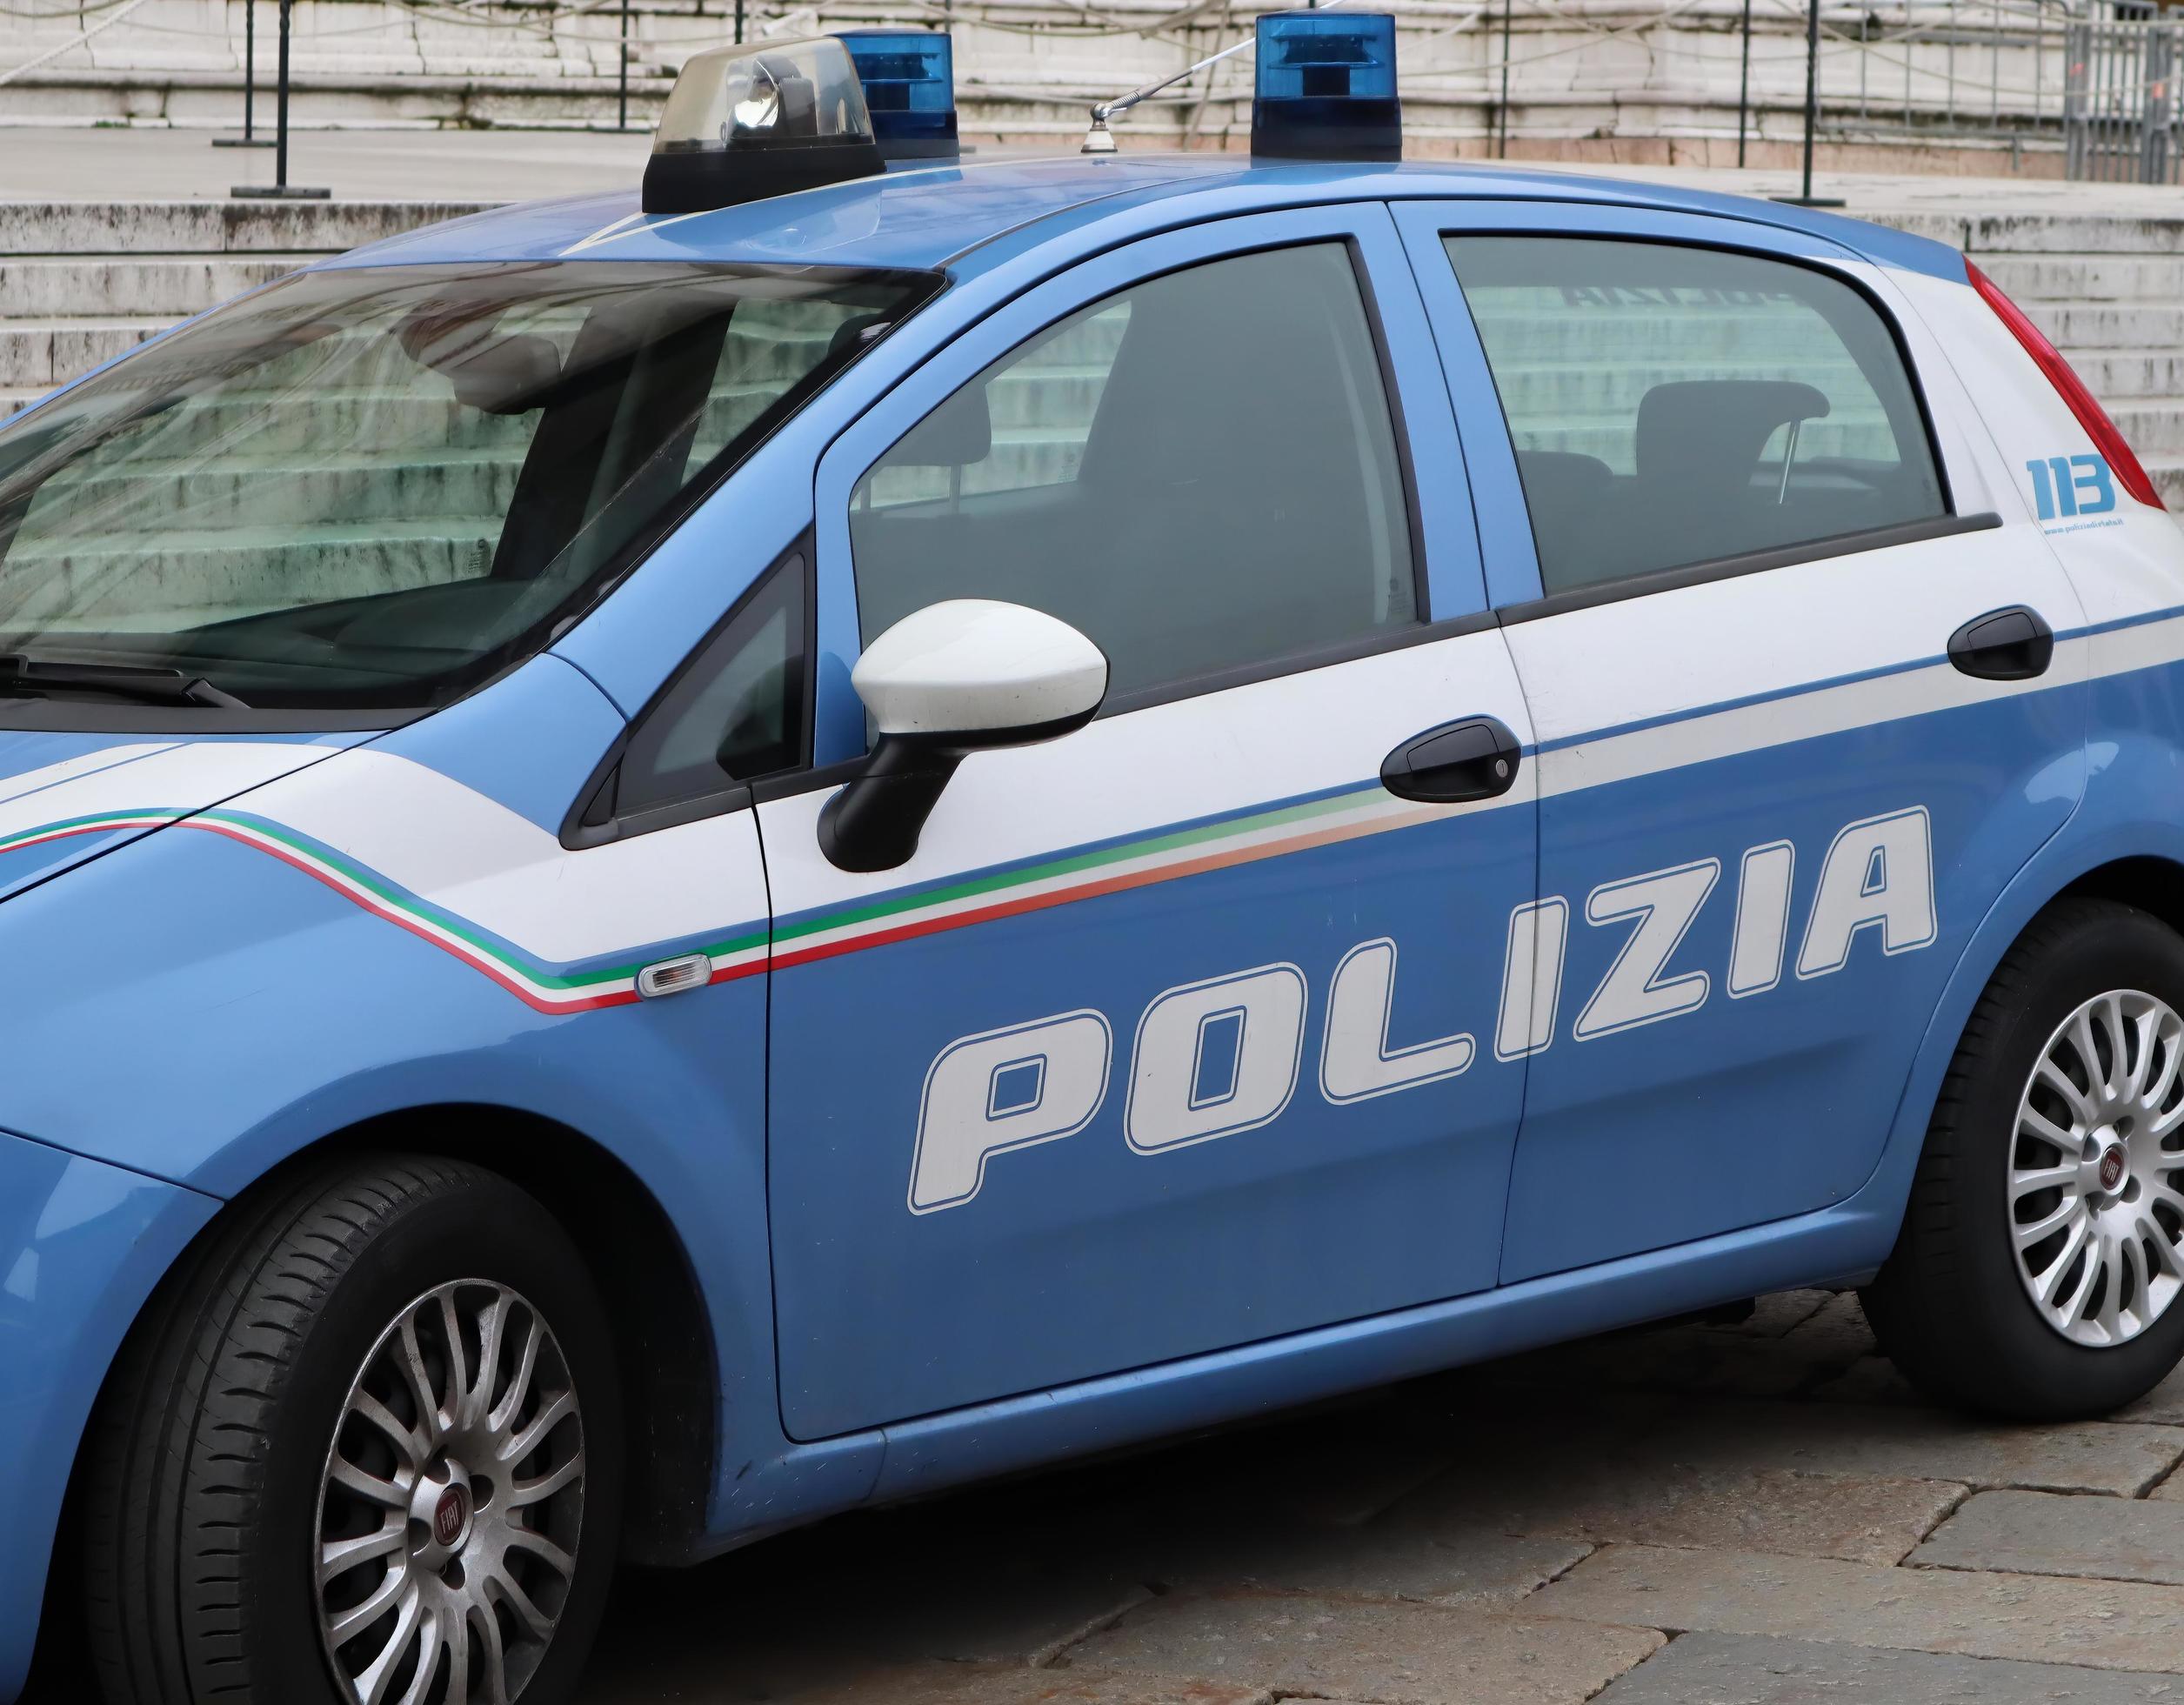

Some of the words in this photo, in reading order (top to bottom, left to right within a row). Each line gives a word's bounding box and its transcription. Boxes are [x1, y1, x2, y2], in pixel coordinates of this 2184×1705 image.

[2027, 454, 2116, 521] 113
[907, 805, 1938, 1216] POLIZIA
[2103, 1159, 2120, 1182] FIAT
[439, 1501, 459, 1534] FIAT
